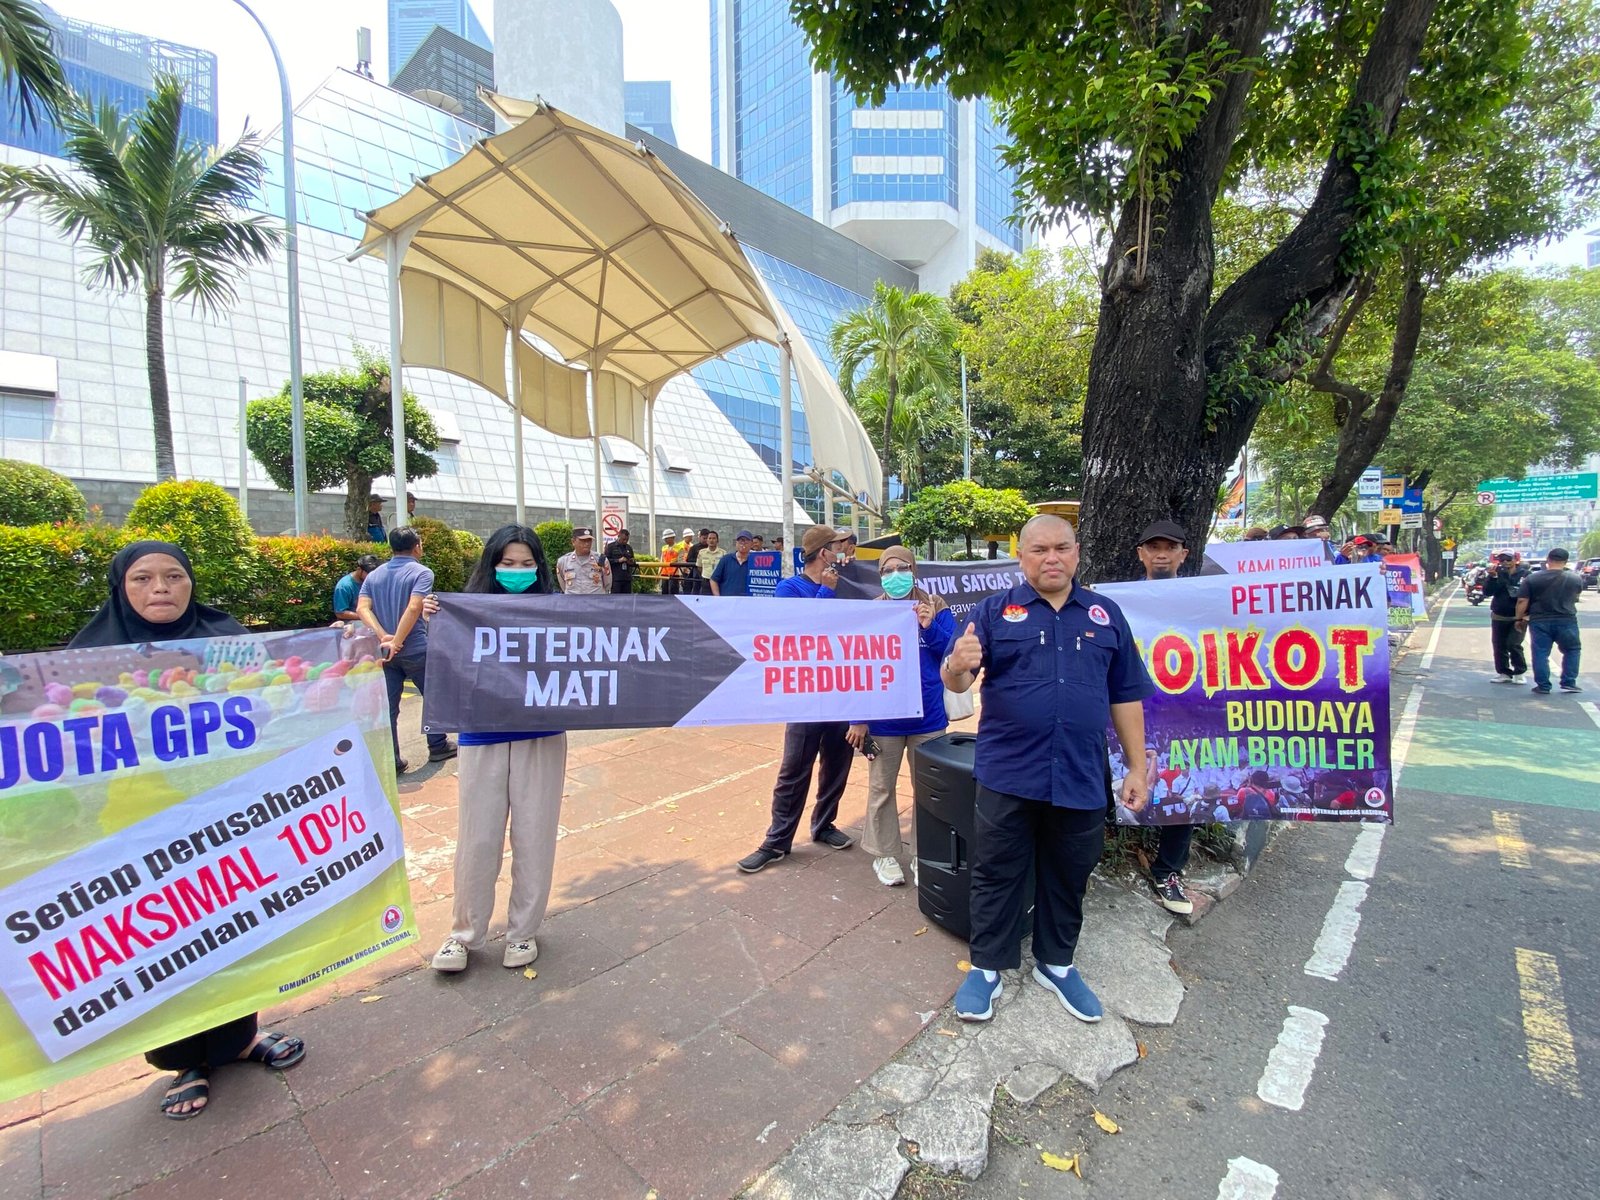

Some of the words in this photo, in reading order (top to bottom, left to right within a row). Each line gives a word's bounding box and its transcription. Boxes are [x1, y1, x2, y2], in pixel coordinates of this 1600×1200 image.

[749, 569, 780, 577] PEMERIKSAAN
[754, 555, 775, 567] STOP
[1237, 558, 1275, 574] KAMI
[750, 577, 777, 585] KENDARAAN
[914, 575, 958, 595] NTUK
[962, 571, 1014, 594] SATGAS
[1231, 576, 1373, 615] PETERNAK
[472, 626, 671, 664] PETERNAK
[753, 633, 832, 664] SIAPA
[838, 633, 902, 661] YANG
[1149, 625, 1377, 696] OIKOT
[524, 670, 618, 707] MATI
[764, 664, 873, 695] PERDULI
[879, 665, 895, 690] ?
[150, 696, 256, 762] GPS
[1227, 700, 1375, 733] BUDIDAYA
[1169, 736, 1238, 771] AYAM
[1248, 736, 1375, 770] BROILER
[5, 863, 141, 944] Setiap
[143, 764, 345, 881] perusahaan
[28, 845, 278, 1000] MAKSIMAL
[278, 796, 366, 866] 10%
[53, 977, 134, 1038] dari
[134, 909, 258, 994] jumlah
[265, 831, 384, 920] Nasional
[278, 970, 321, 993] KOMUNITAS
[321, 955, 355, 976] PETERNAK
[354, 943, 381, 960] UNGGAS
[381, 930, 411, 949] NASIONAL
